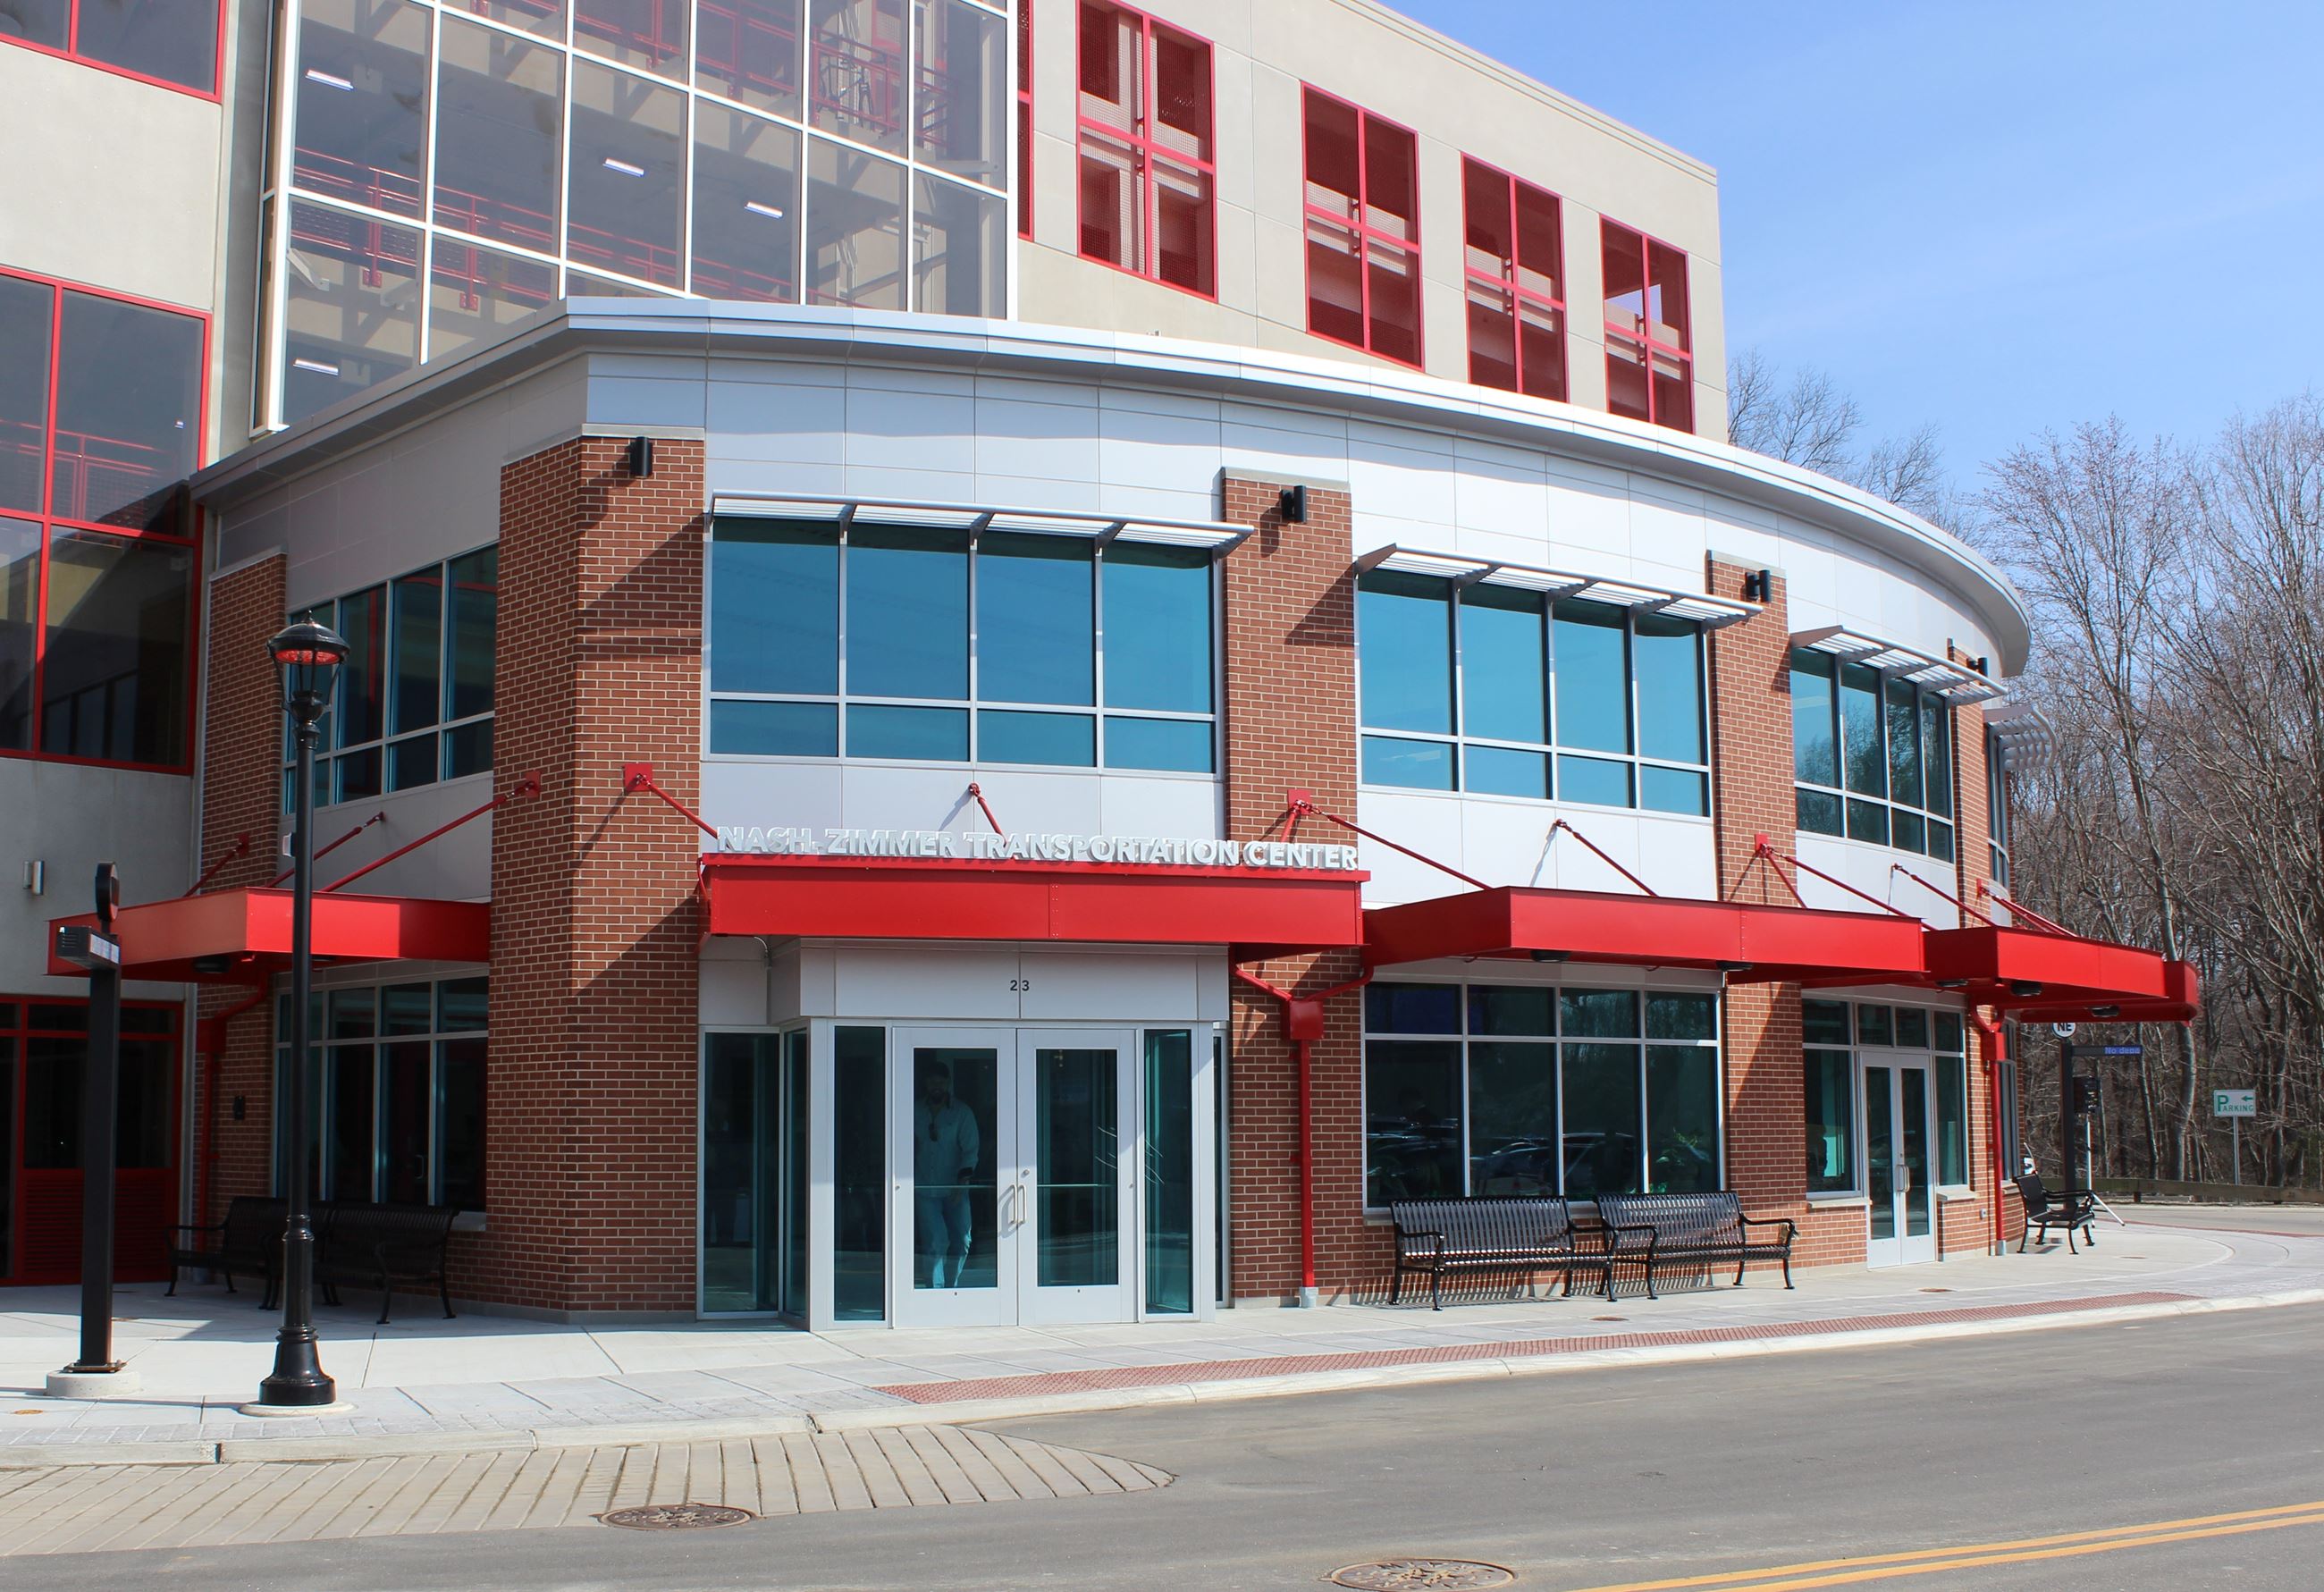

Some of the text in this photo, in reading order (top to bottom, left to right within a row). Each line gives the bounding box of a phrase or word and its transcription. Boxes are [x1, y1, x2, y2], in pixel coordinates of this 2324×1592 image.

[963, 832, 1240, 865] TRANSPORTATION
[1242, 840, 1358, 870] CENTER
[1010, 980, 1030, 991] 23
[2218, 1095, 2253, 1111] PARKING
